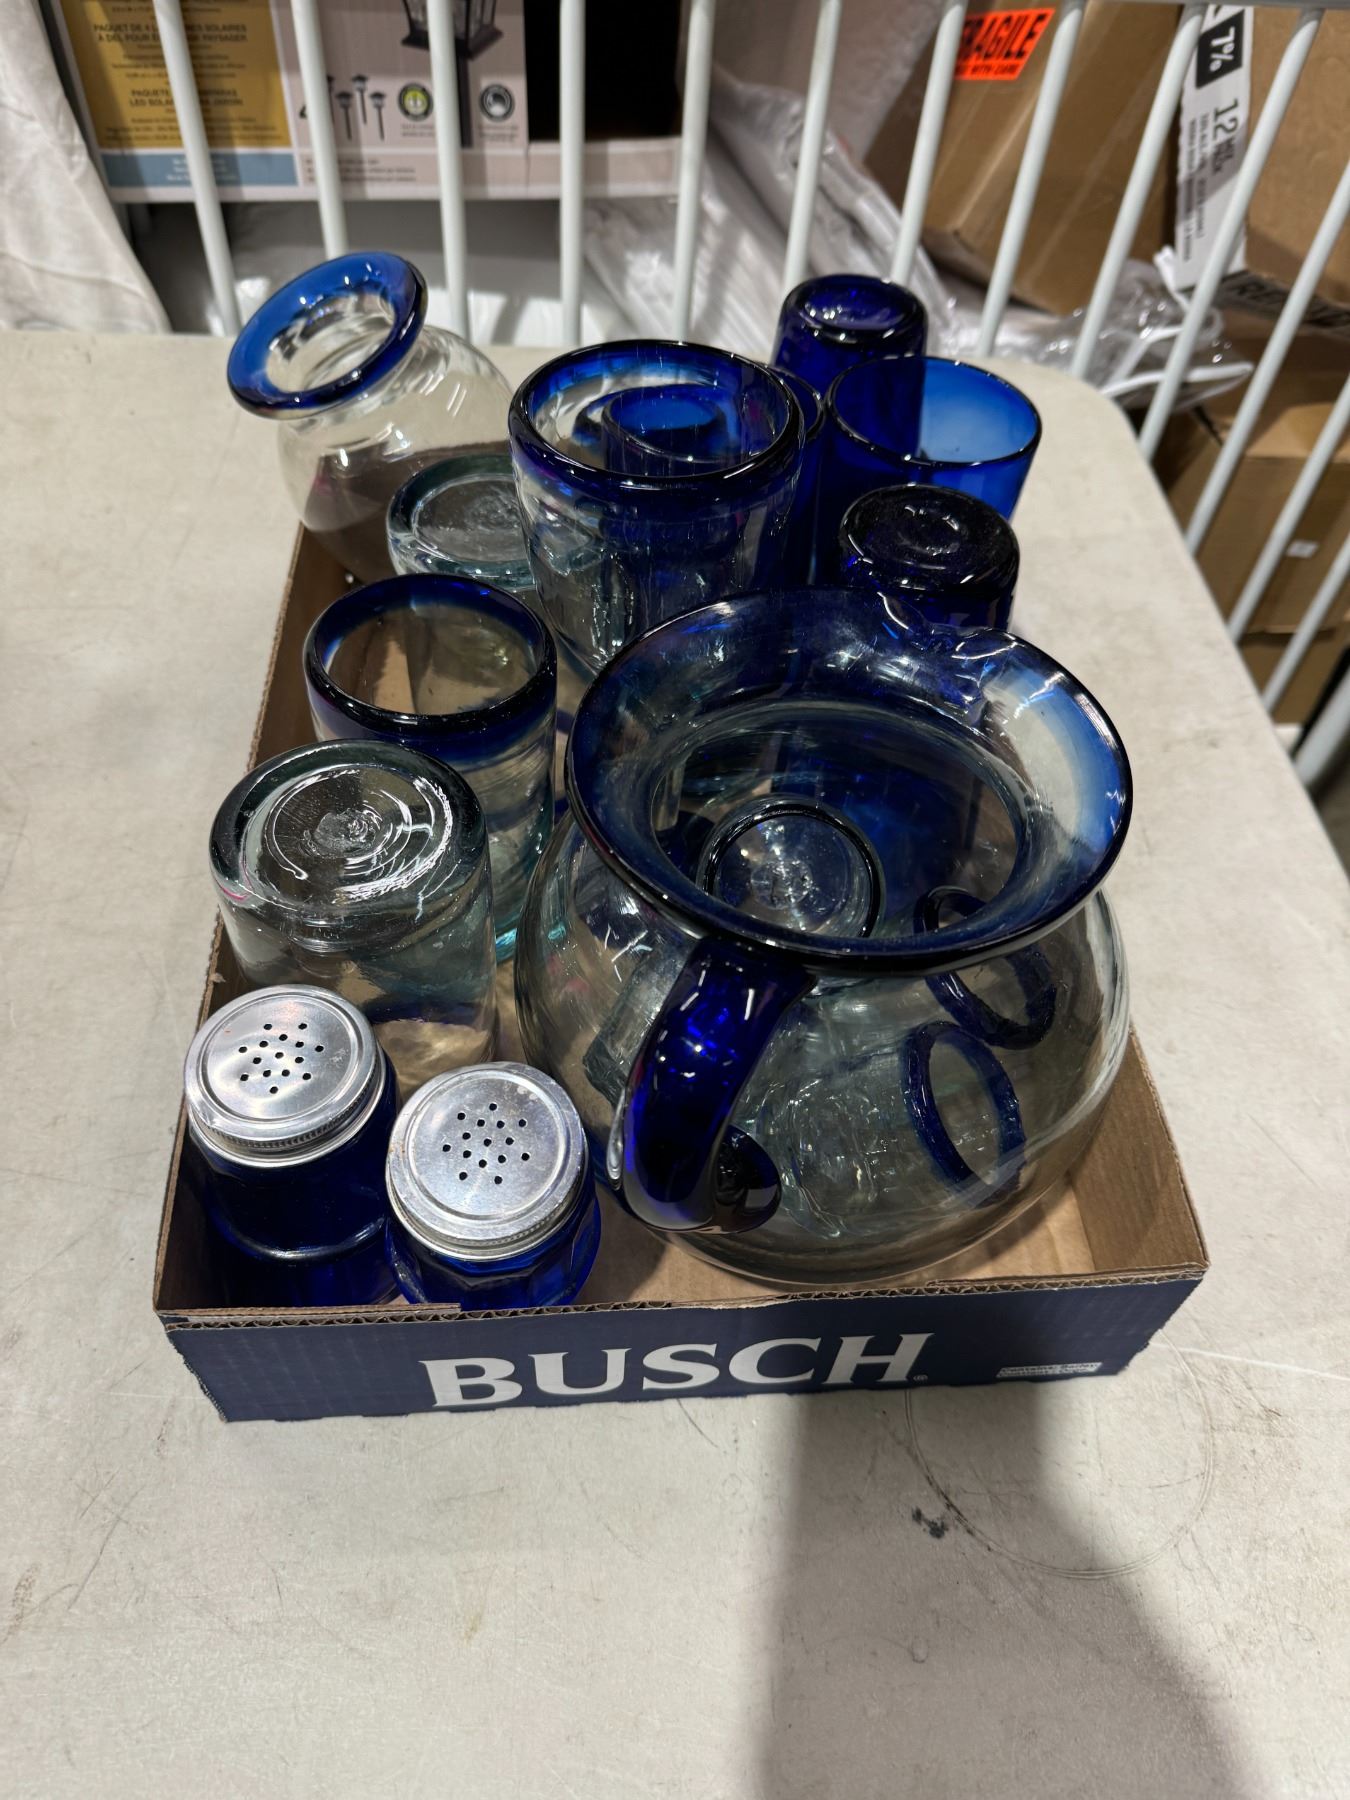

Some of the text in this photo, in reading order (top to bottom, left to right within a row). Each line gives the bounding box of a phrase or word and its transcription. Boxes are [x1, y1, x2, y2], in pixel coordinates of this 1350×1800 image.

[1209, 26, 1235, 72] 7%
[1213, 98, 1238, 141] 12
[418, 1332, 934, 1407] BUSCH
